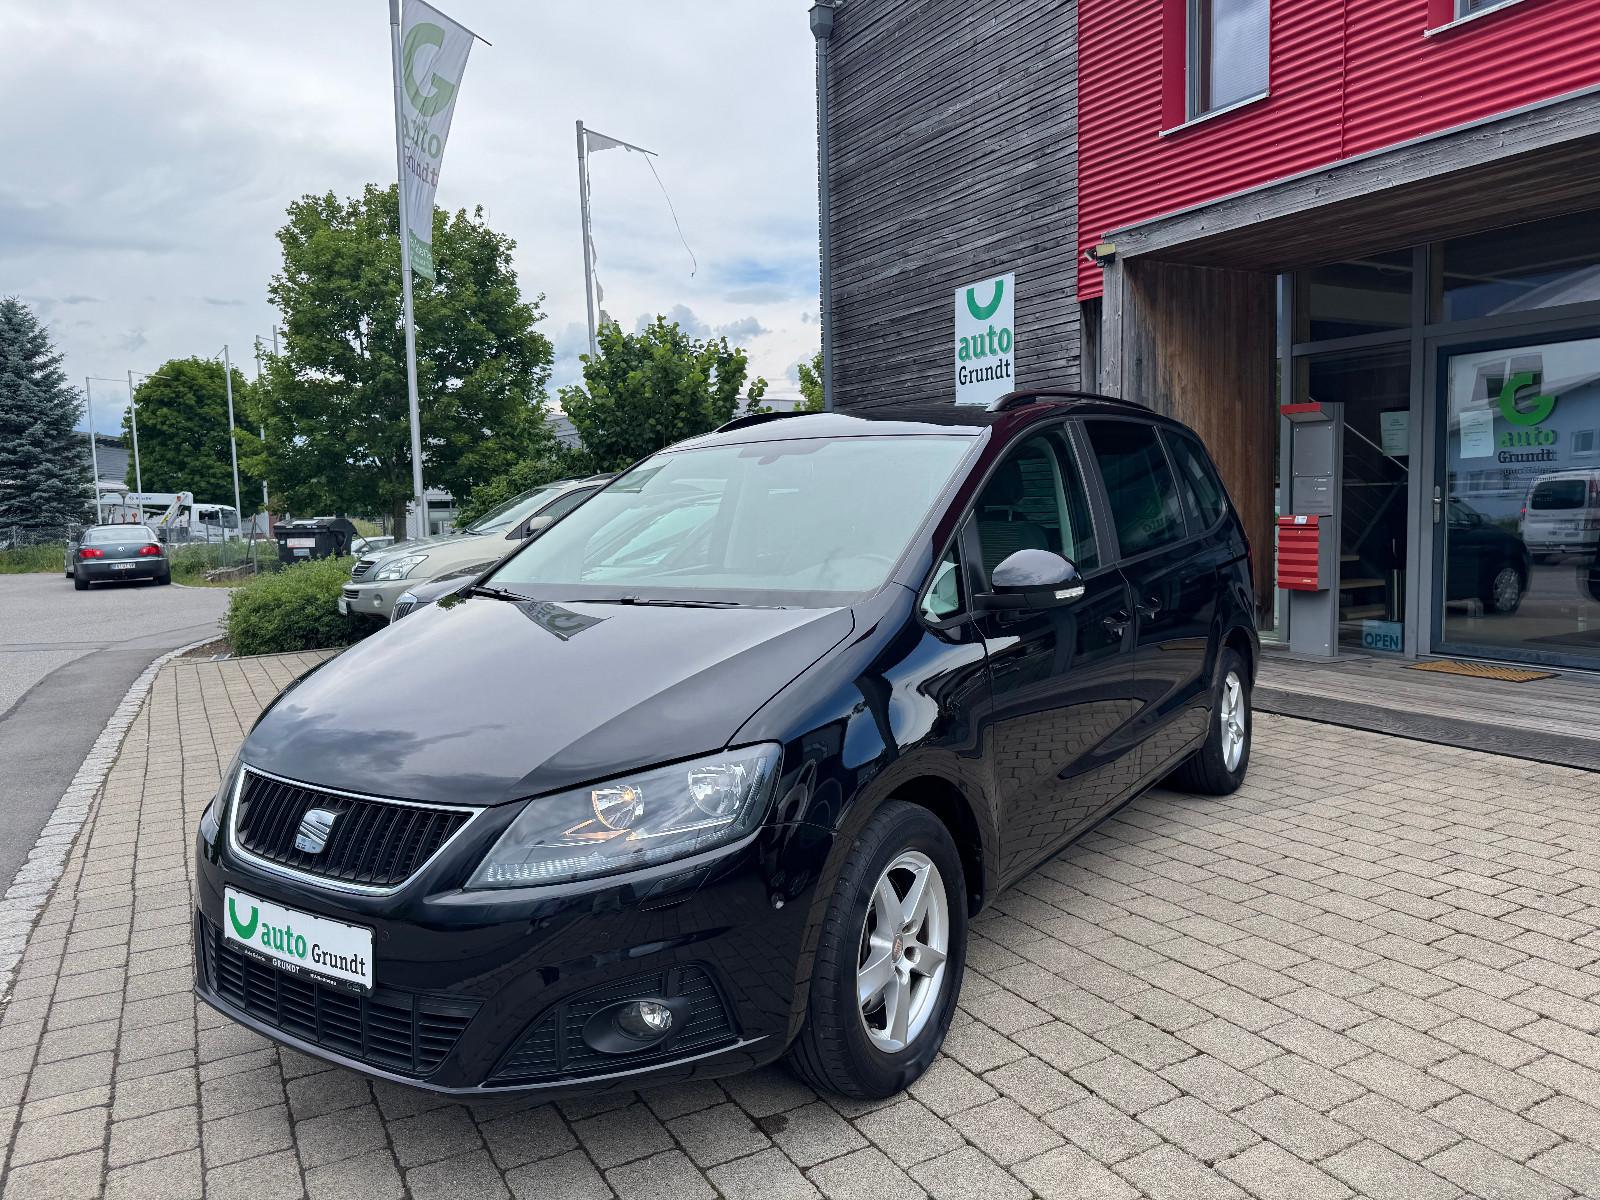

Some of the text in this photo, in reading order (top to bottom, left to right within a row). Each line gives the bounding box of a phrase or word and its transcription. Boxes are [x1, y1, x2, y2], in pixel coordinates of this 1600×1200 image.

[403, 22, 455, 117] G
[958, 324, 1013, 362] auto
[958, 358, 1011, 386] Grundt
[1499, 427, 1556, 448] auto
[1498, 449, 1554, 464] Grundt
[1364, 632, 1399, 649] OPEN
[261, 922, 366, 977] auto Grundt
[272, 958, 300, 974] GRUNDT
